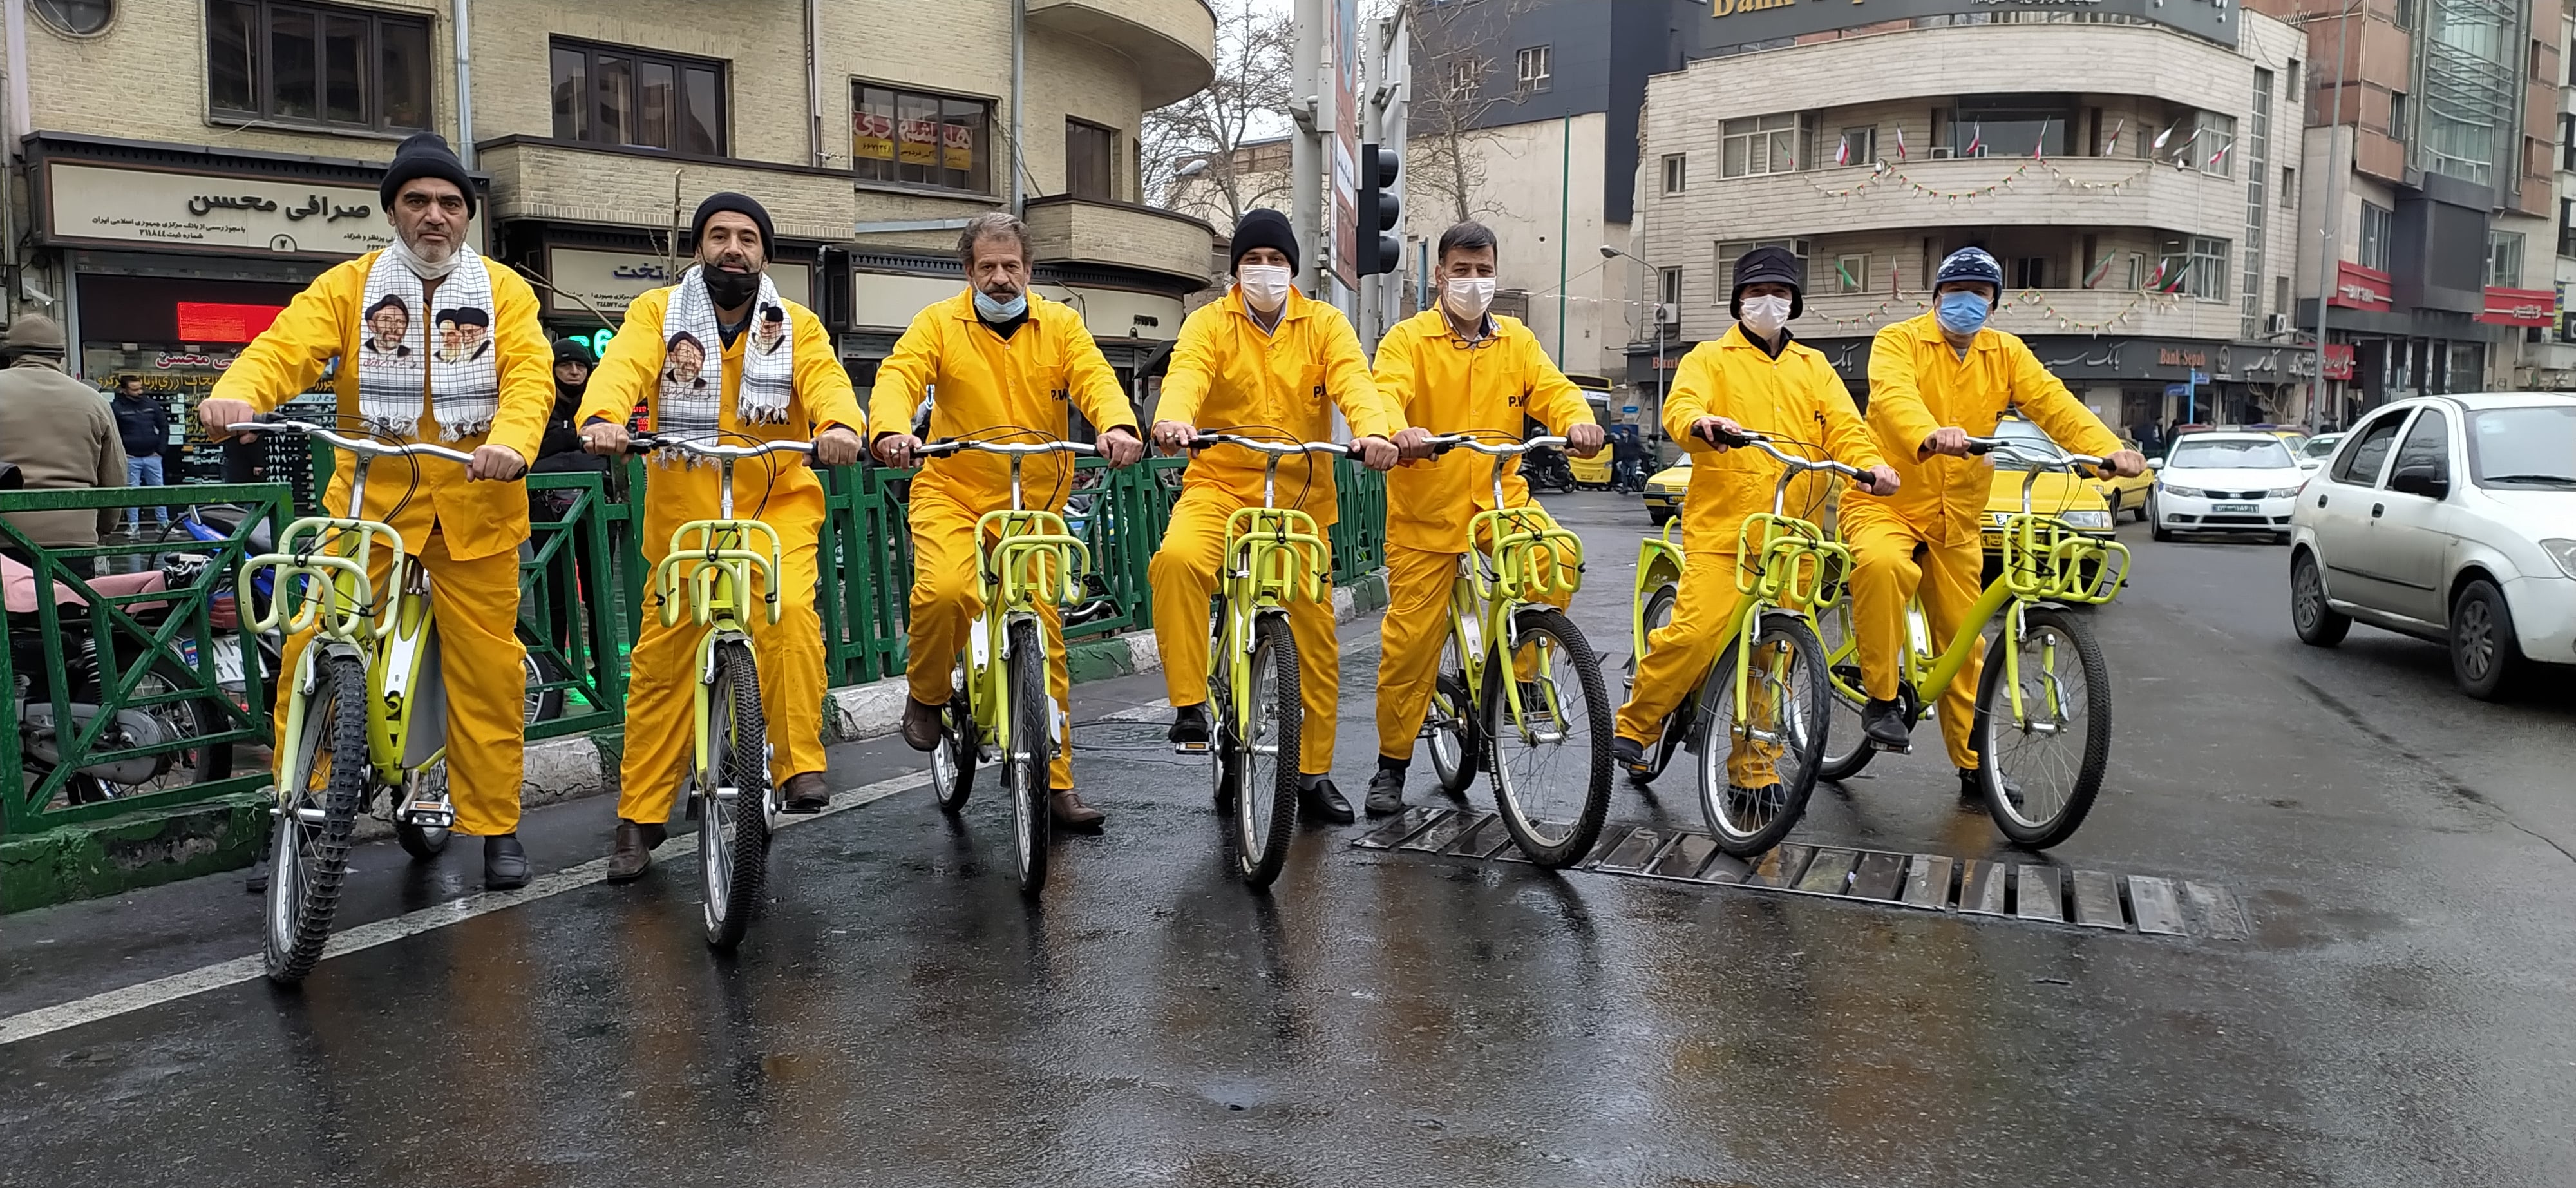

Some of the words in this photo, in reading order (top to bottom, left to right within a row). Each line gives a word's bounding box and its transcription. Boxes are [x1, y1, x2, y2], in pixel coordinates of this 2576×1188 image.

[188, 195, 278, 216] محسن
[285, 194, 372, 223] صرافی
[135, 220, 160, 228] جمهوری
[155, 351, 210, 368] محسن
[2087, 340, 2128, 371] بانک
[2160, 348, 2180, 365] Bank
[2183, 349, 2206, 367] Sepah
[1488, 740, 1497, 773] Rubber
